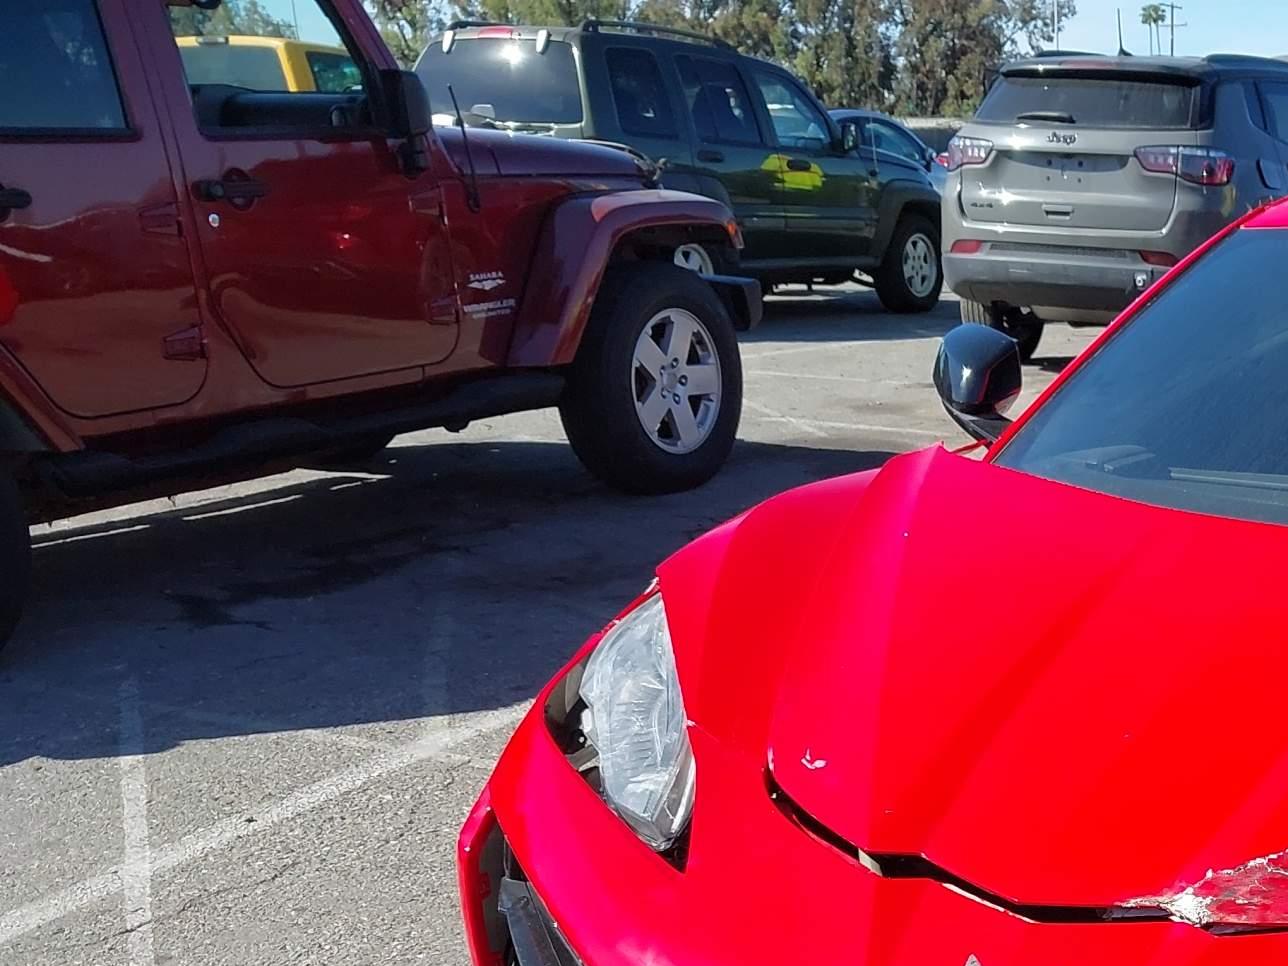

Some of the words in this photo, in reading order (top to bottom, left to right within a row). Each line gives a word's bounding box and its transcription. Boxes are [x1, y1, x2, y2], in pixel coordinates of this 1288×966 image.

[1046, 131, 1078, 146] Jeep
[469, 271, 504, 281] SAHARA
[463, 298, 516, 313] WRANGLER
